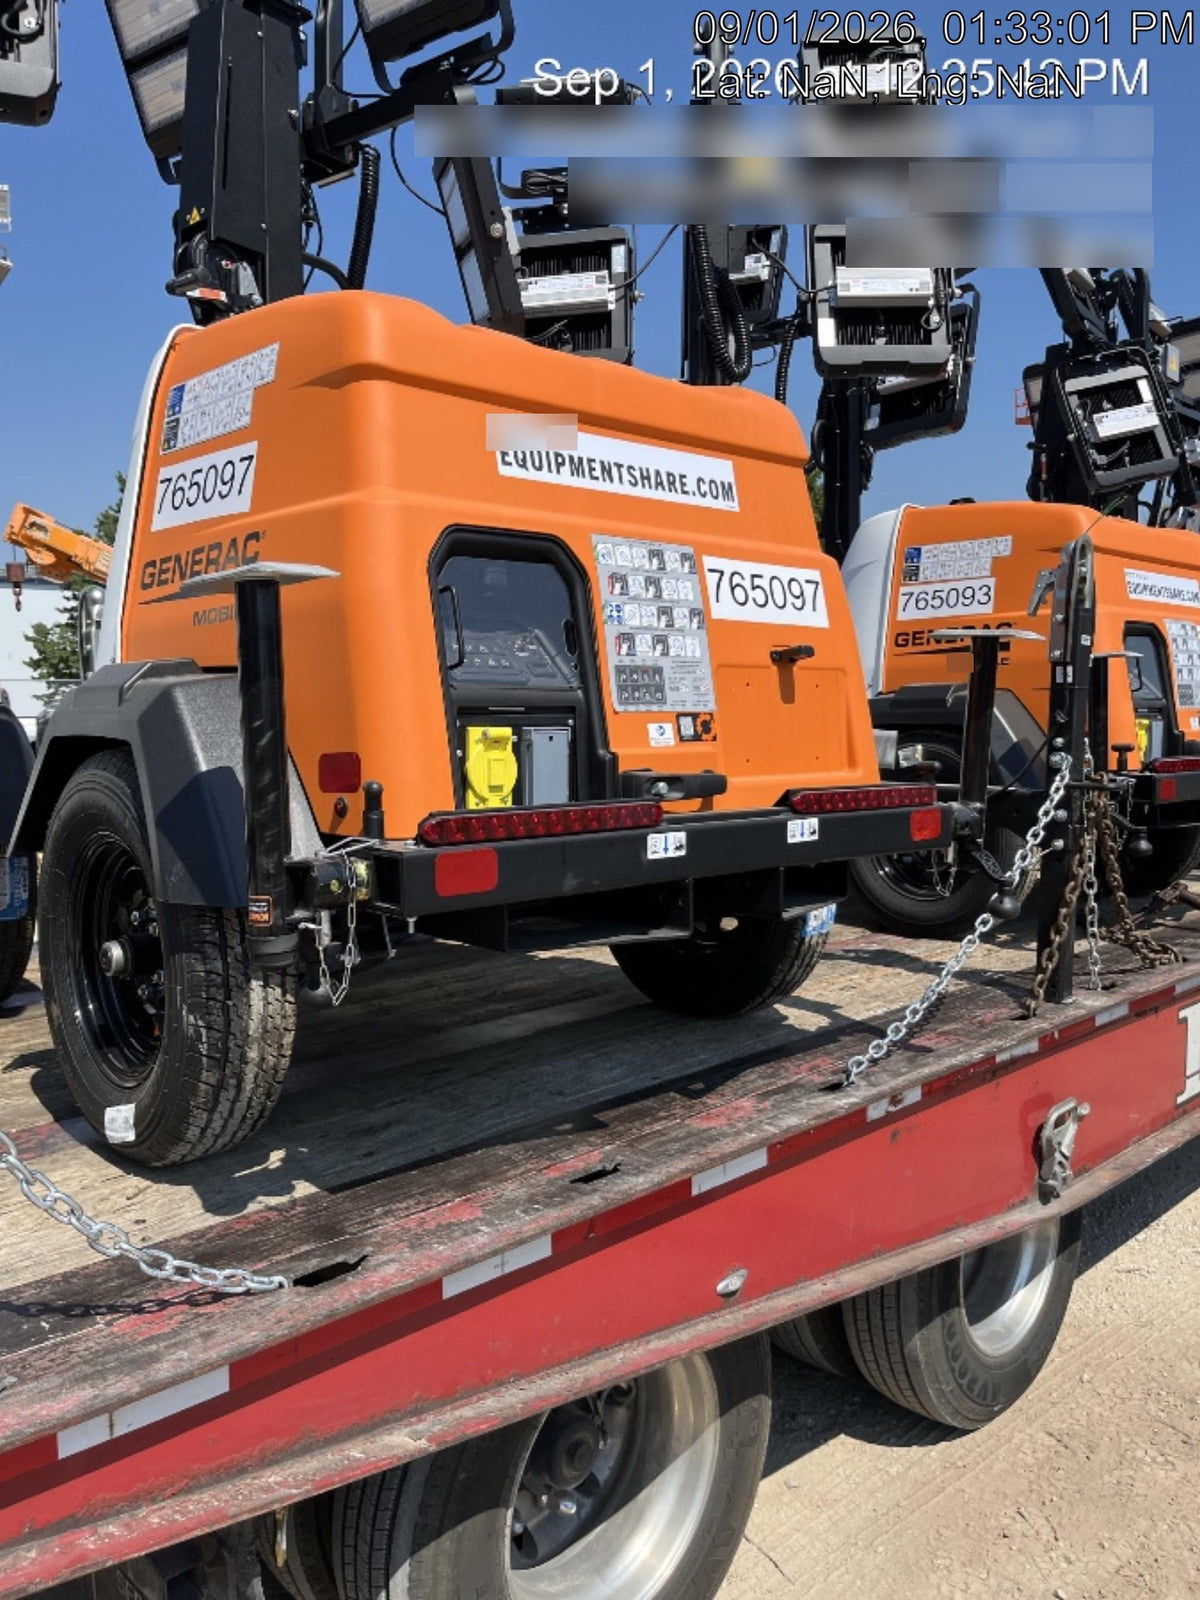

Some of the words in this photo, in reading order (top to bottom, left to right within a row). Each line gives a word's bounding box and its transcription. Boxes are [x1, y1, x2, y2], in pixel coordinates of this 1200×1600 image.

[157, 455, 255, 514] 765097
[500, 450, 735, 502] EQUIPMENTSHARE.COM
[141, 531, 261, 591] GENERAC
[707, 568, 821, 612] 765097
[901, 584, 992, 613] 765093
[193, 604, 238, 627] MOBI
